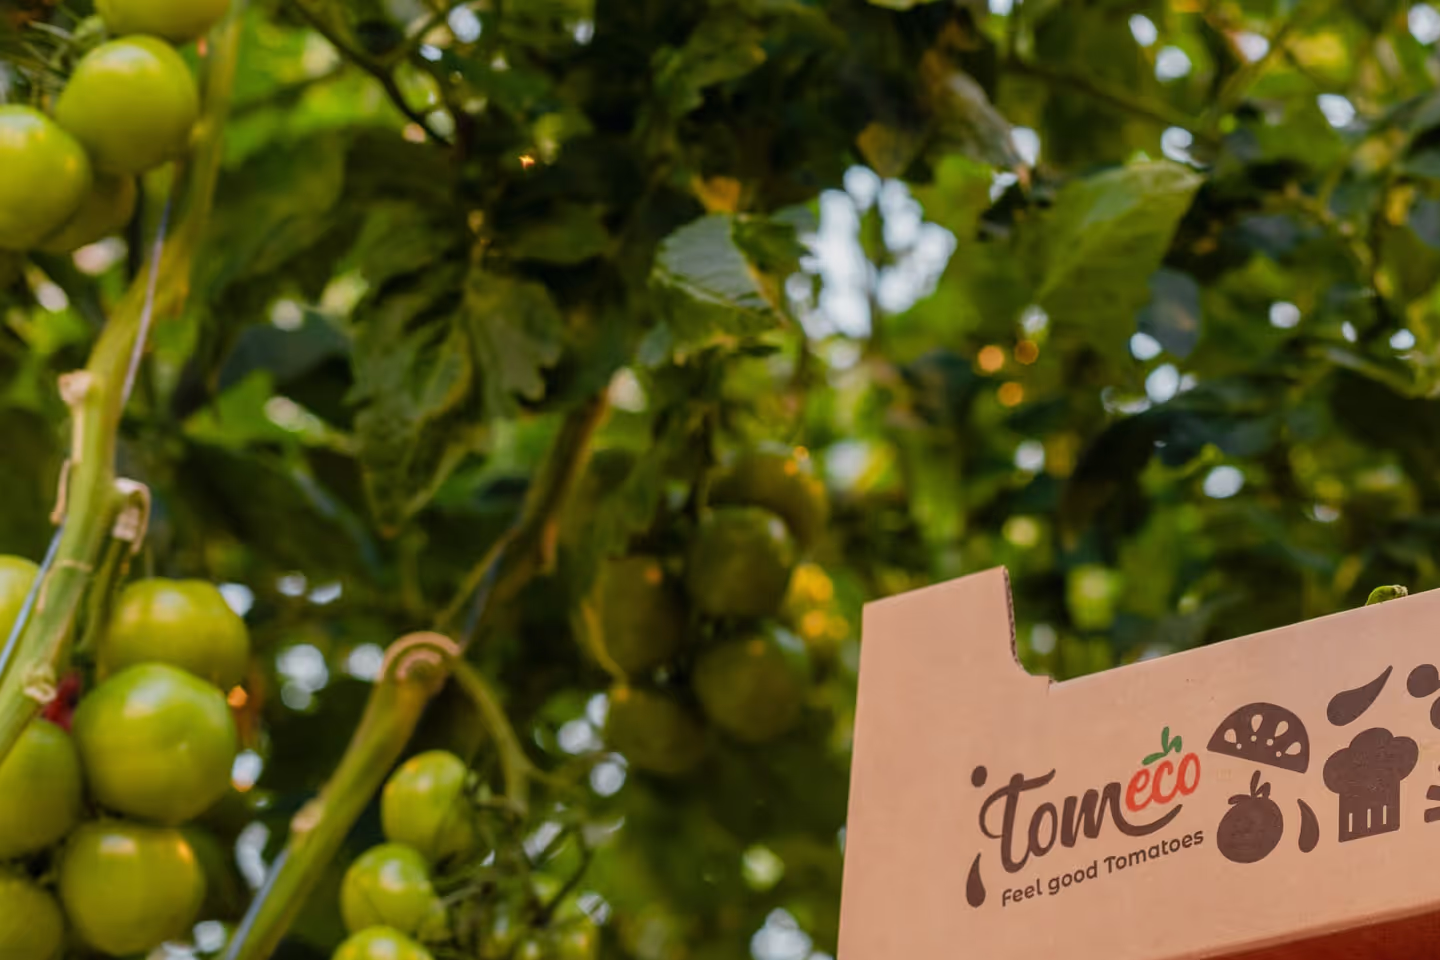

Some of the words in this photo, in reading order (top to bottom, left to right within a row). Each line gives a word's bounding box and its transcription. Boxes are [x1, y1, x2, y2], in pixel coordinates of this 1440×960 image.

[978, 752, 1201, 874] Tomeco
[1001, 878, 1043, 907] Feel
[1047, 860, 1098, 896] good
[1103, 829, 1205, 875] Tomatoes
